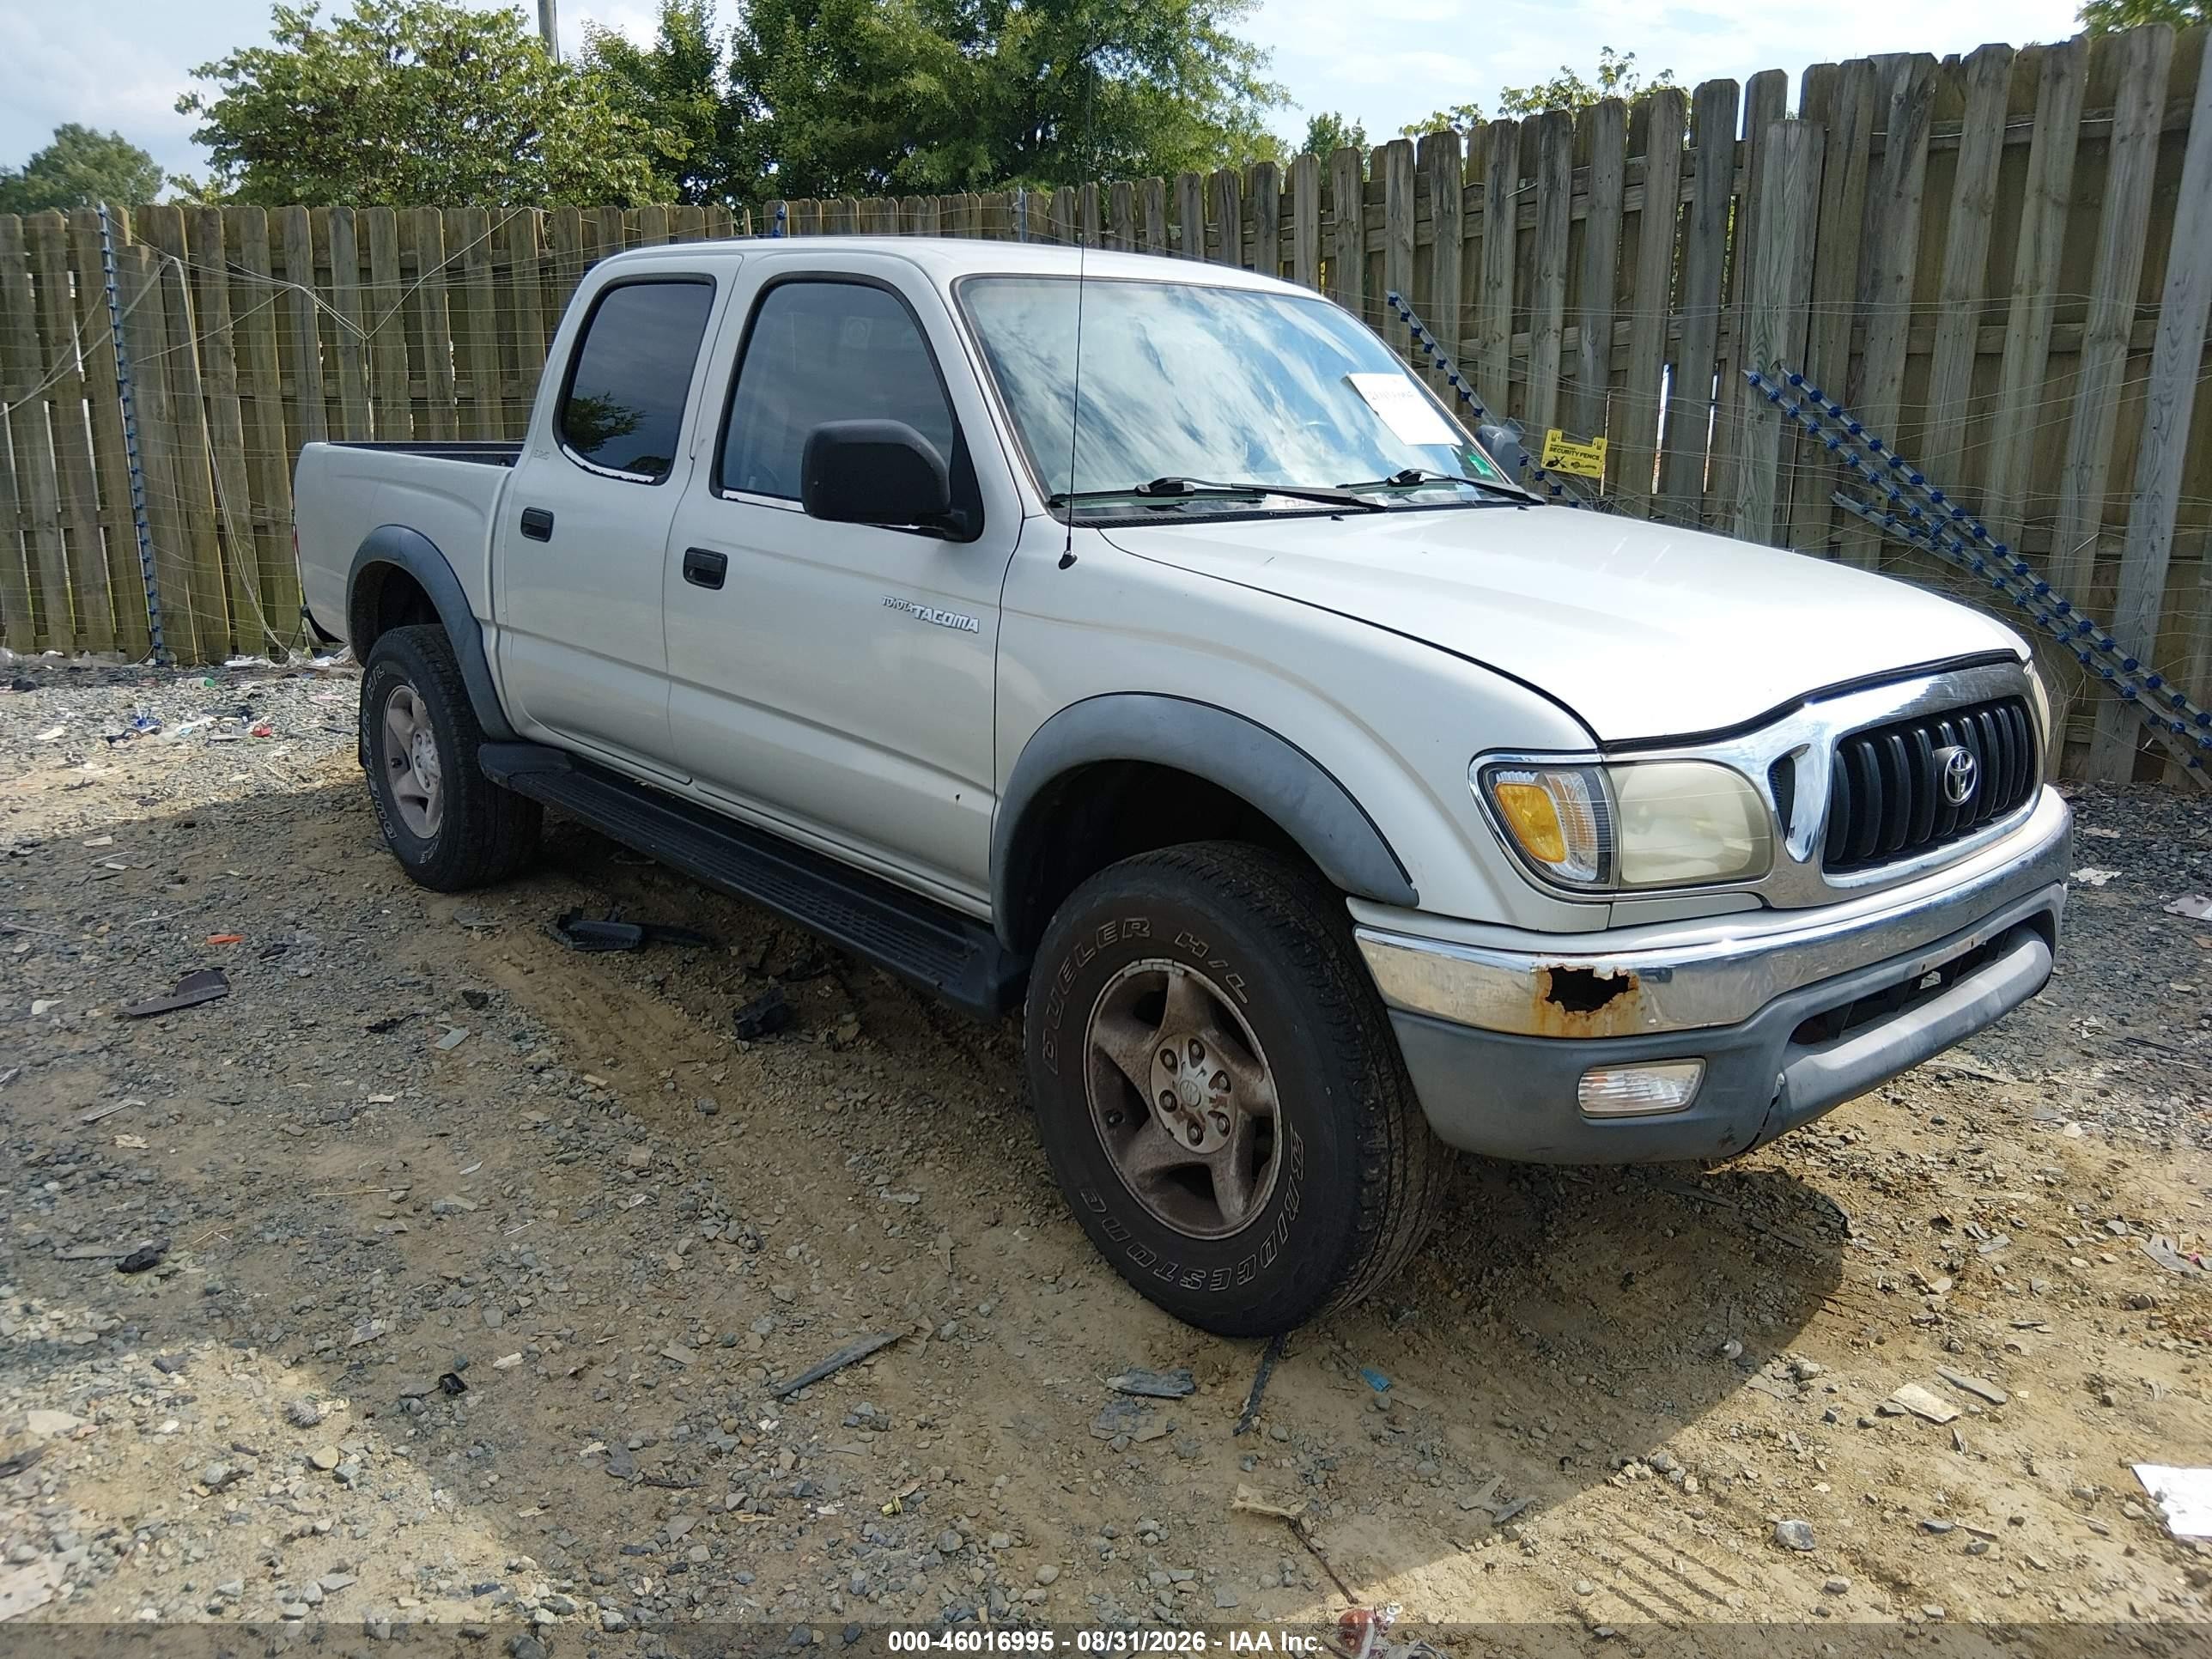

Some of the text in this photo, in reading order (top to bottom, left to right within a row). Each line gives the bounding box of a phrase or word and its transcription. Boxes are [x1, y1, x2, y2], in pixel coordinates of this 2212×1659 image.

[1549, 447, 1579, 457] SECURITY
[1580, 452, 1600, 461] FENCE
[881, 595, 980, 634] TOYOTA TACOMA
[1042, 916, 1153, 1076] DUELER
[1079, 1119, 1307, 1292] BRIDGESTONE
